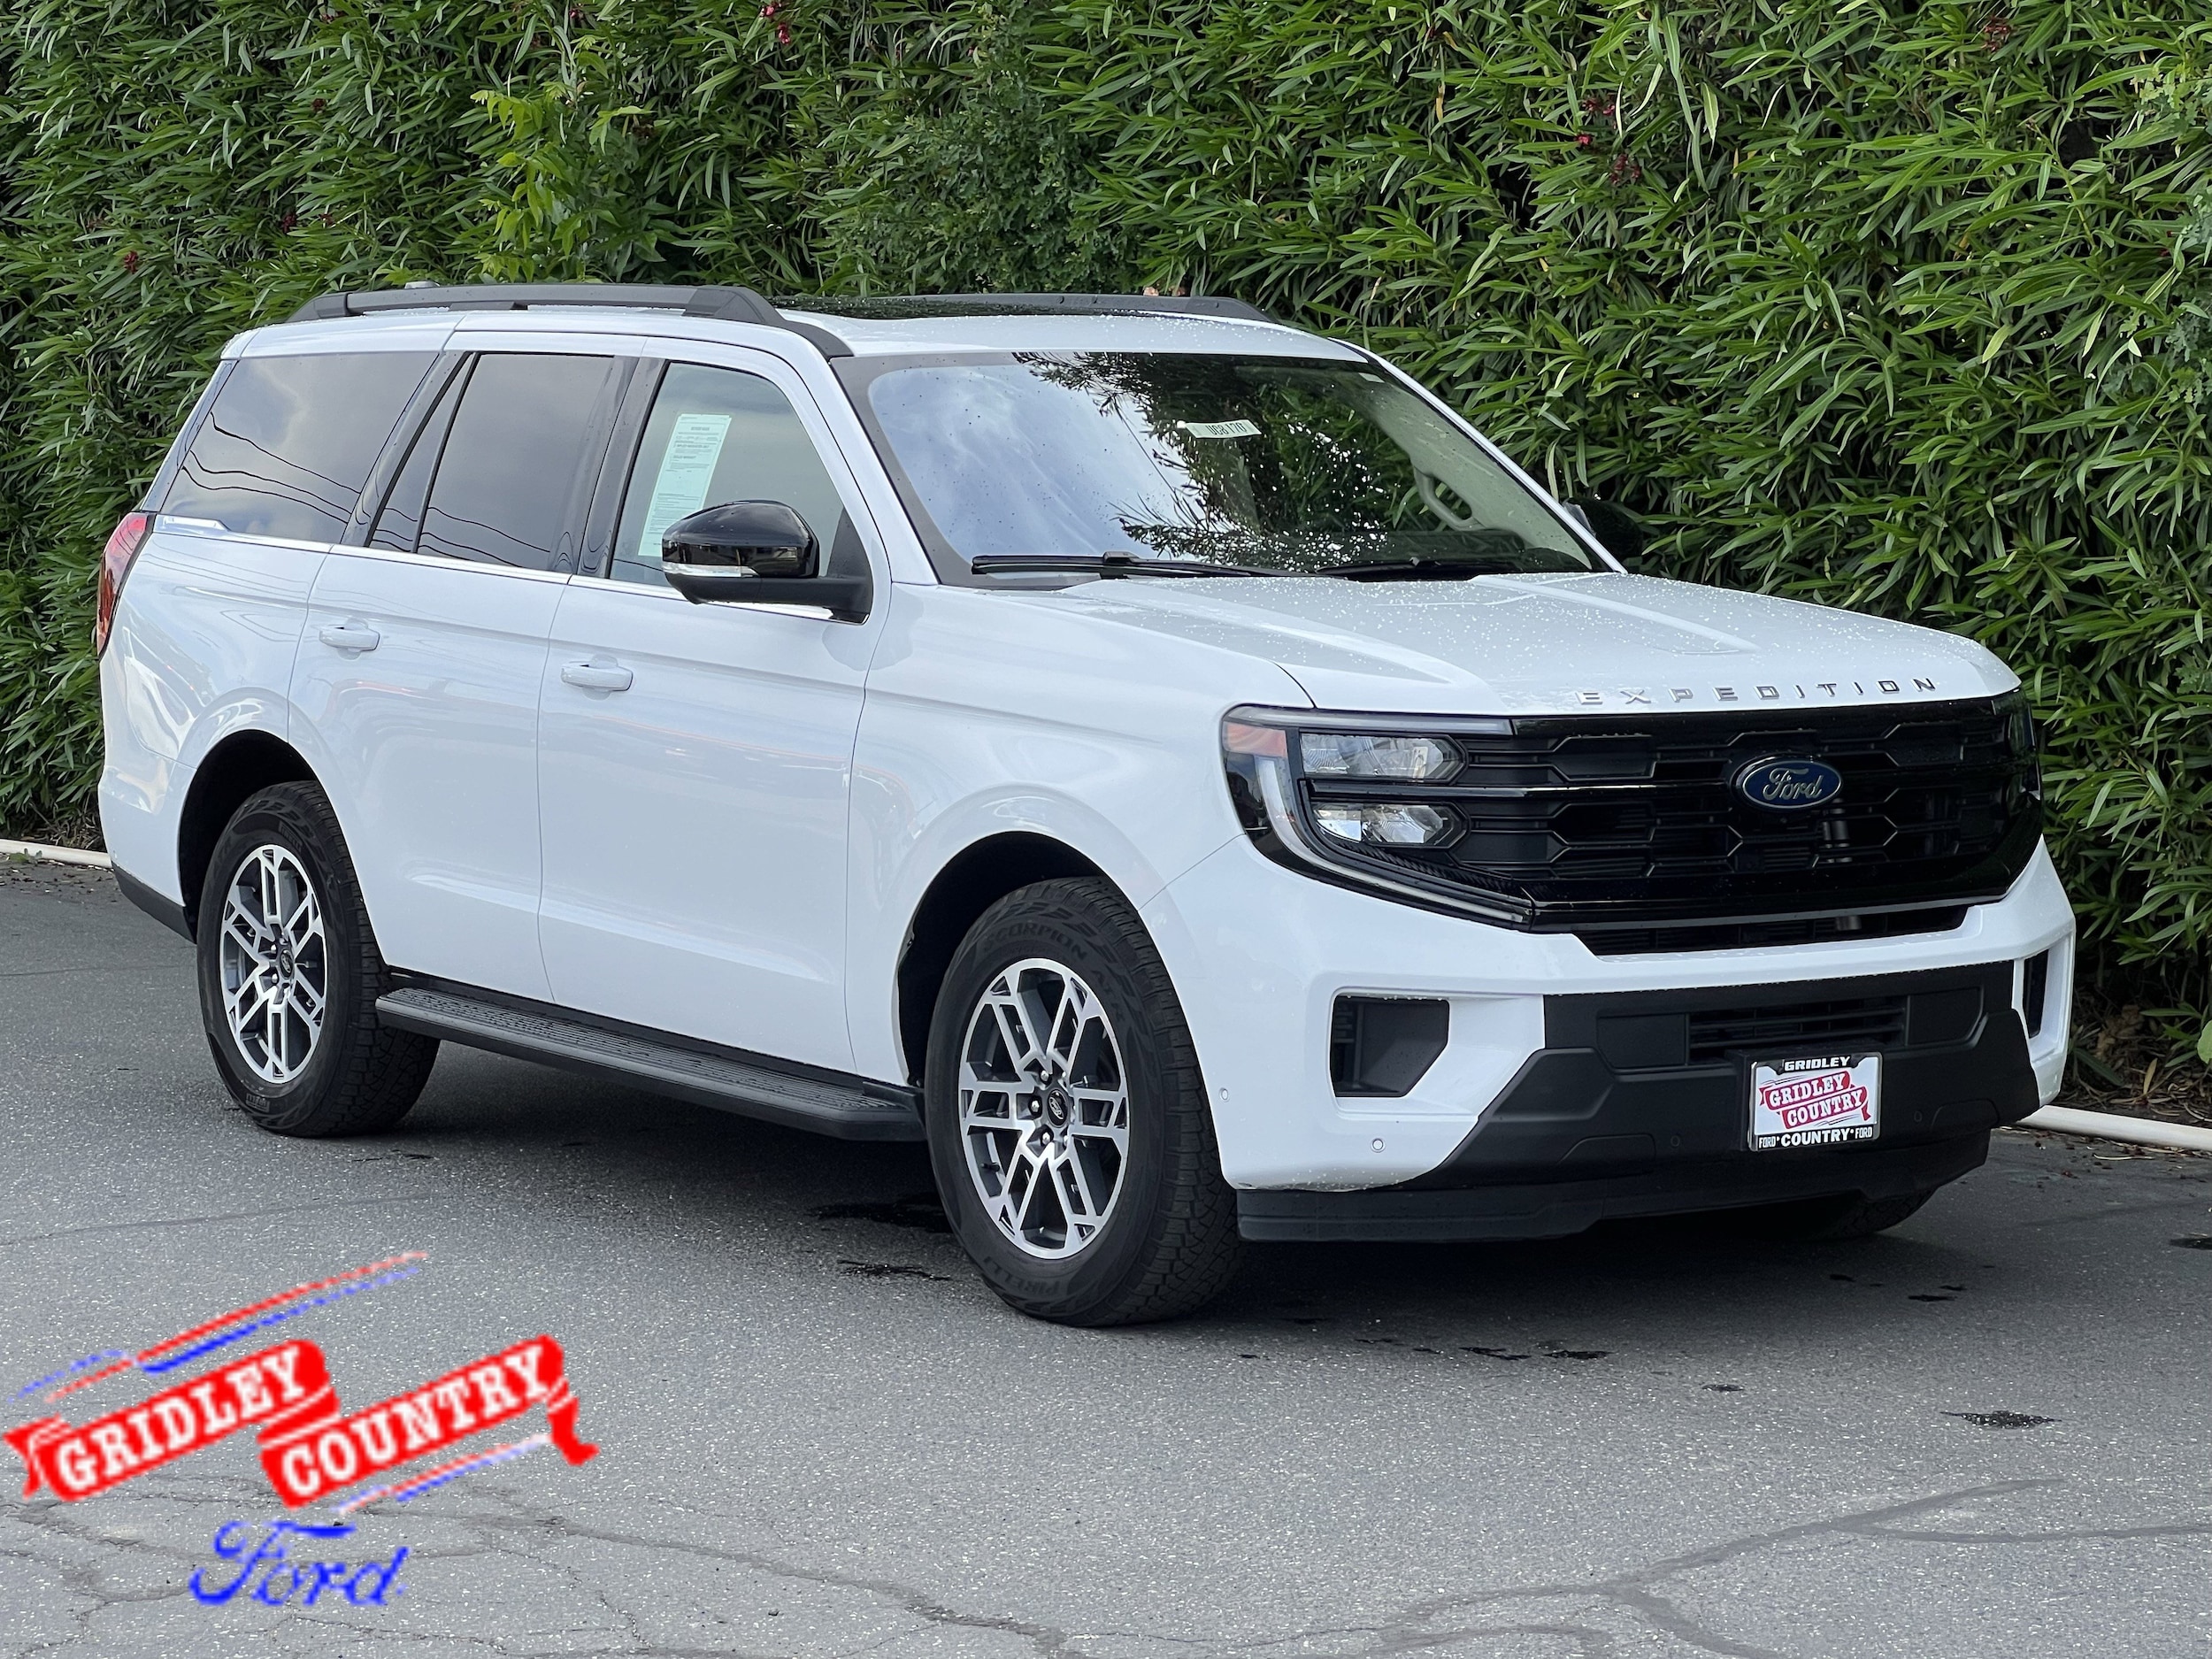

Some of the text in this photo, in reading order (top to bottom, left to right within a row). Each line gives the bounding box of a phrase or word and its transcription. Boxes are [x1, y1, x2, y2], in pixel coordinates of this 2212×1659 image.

[1575, 678, 1936, 705] EXPEDITION
[1763, 768, 1824, 801] Ford
[1784, 1056, 1850, 1071] GRIDLEY
[1769, 1073, 1846, 1108] GRIDLEY
[1786, 1088, 1864, 1127] COUNTRY
[1780, 1128, 1850, 1148] COUNTRY
[1855, 1126, 1873, 1140] FORD
